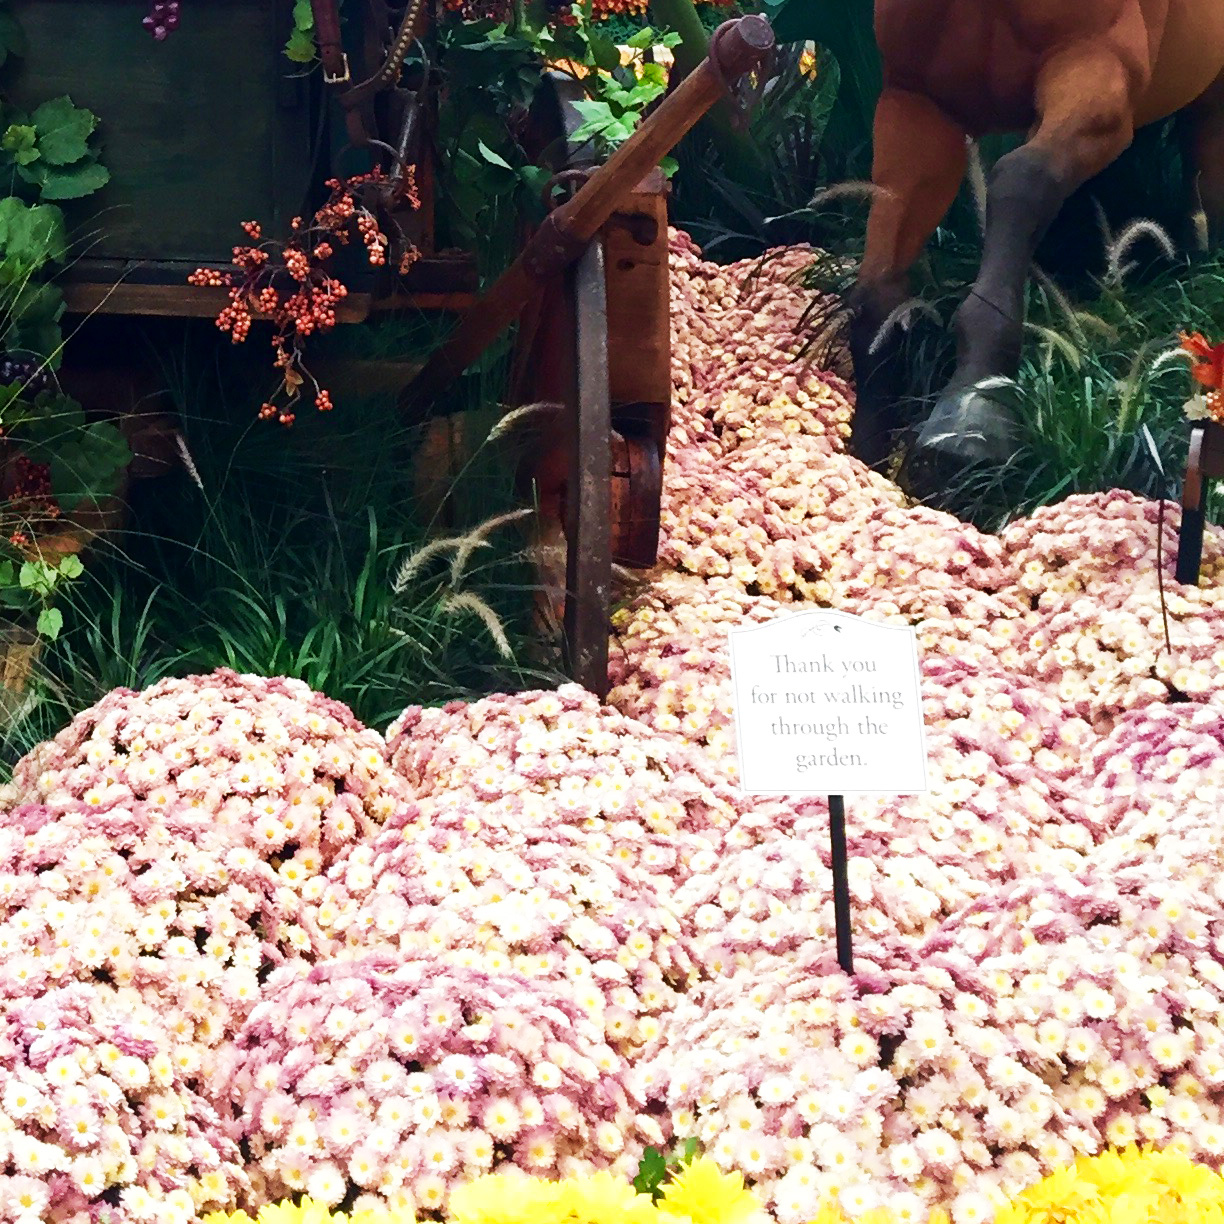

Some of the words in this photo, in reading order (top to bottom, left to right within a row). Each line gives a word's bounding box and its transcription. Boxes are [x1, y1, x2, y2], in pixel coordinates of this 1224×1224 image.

[770, 653, 835, 674] Thank
[841, 659, 877, 678] you
[751, 684, 777, 705] for
[785, 689, 816, 705] not
[824, 683, 905, 710] walking
[771, 715, 850, 742] through
[858, 715, 889, 736] the
[795, 747, 868, 773] garden.
